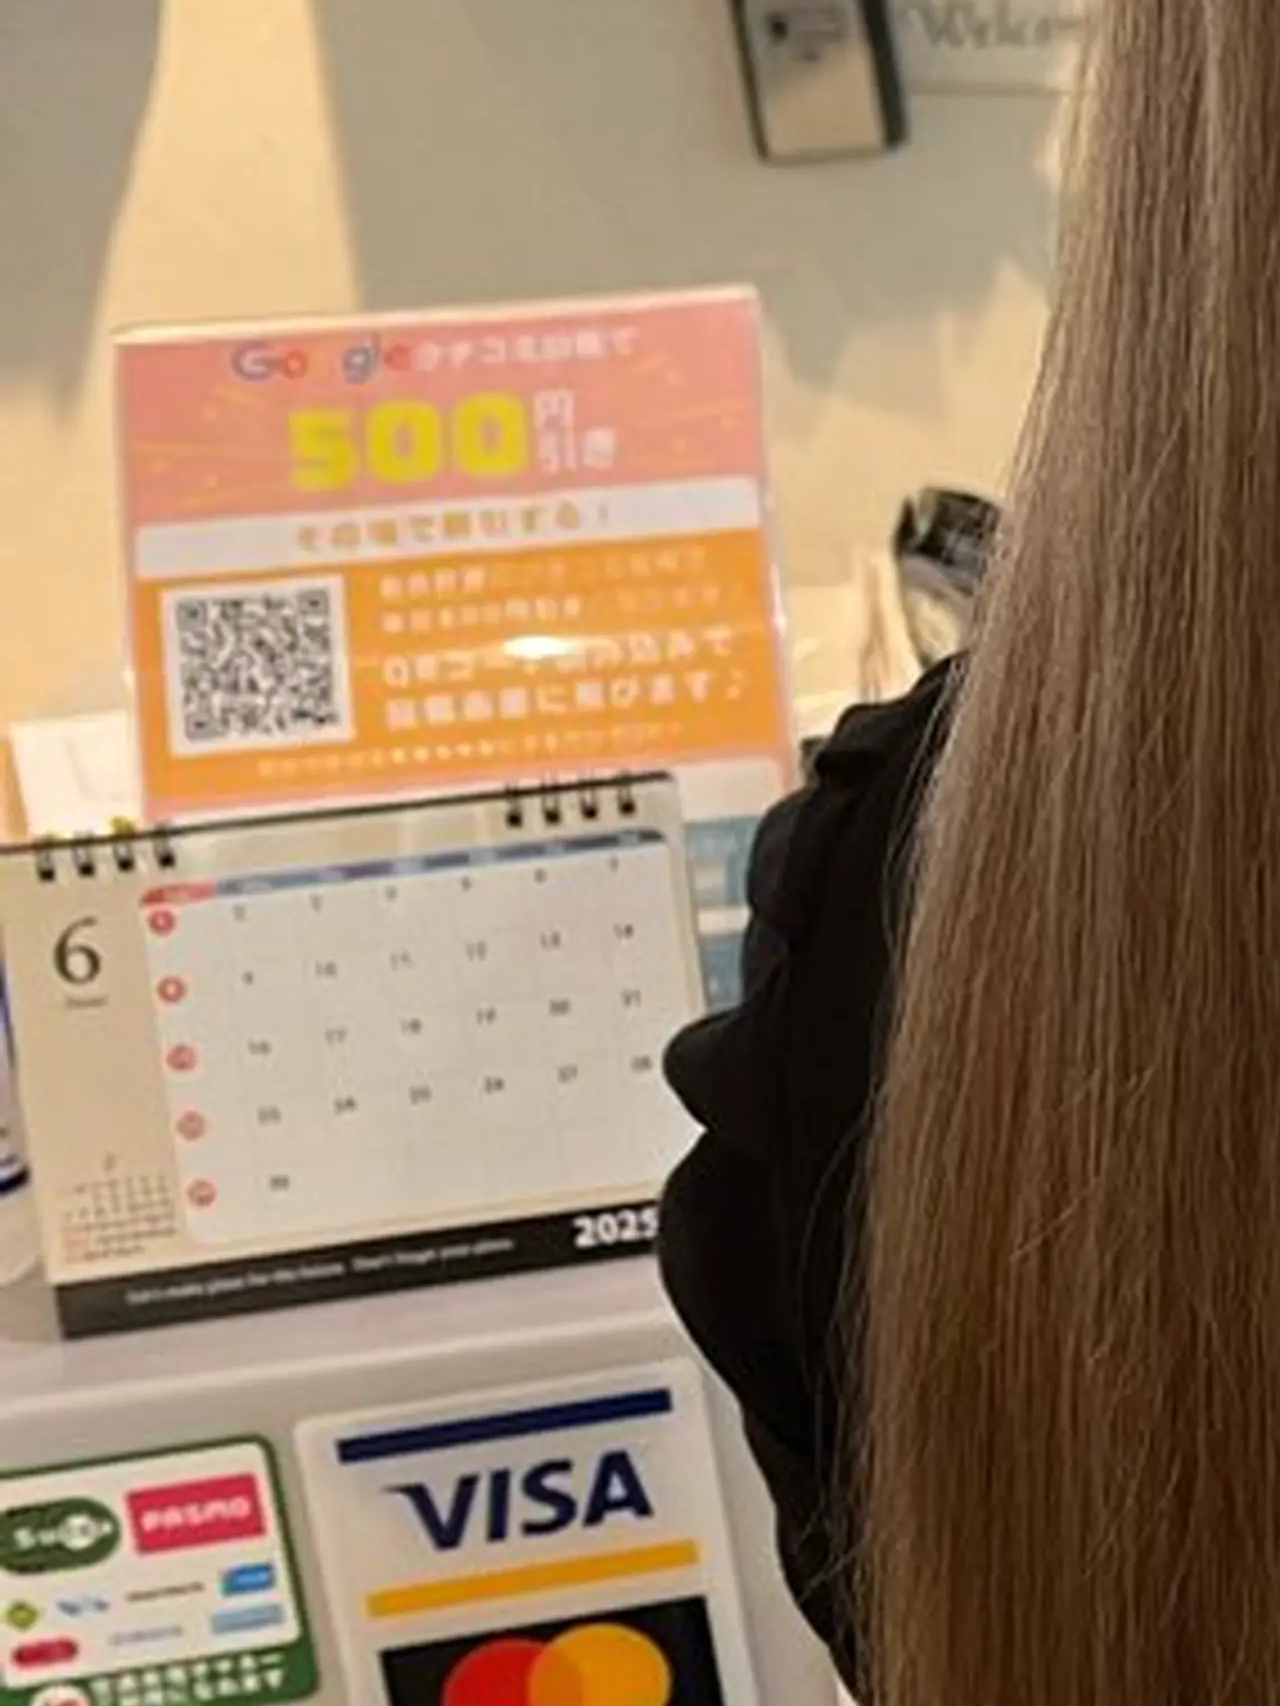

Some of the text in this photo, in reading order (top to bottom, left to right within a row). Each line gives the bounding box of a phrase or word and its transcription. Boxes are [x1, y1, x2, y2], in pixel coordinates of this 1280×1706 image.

[288, 391, 528, 493] 500
[54, 916, 101, 985] 6
[572, 1206, 660, 1251] 2025
[384, 1449, 654, 1551] VISA
